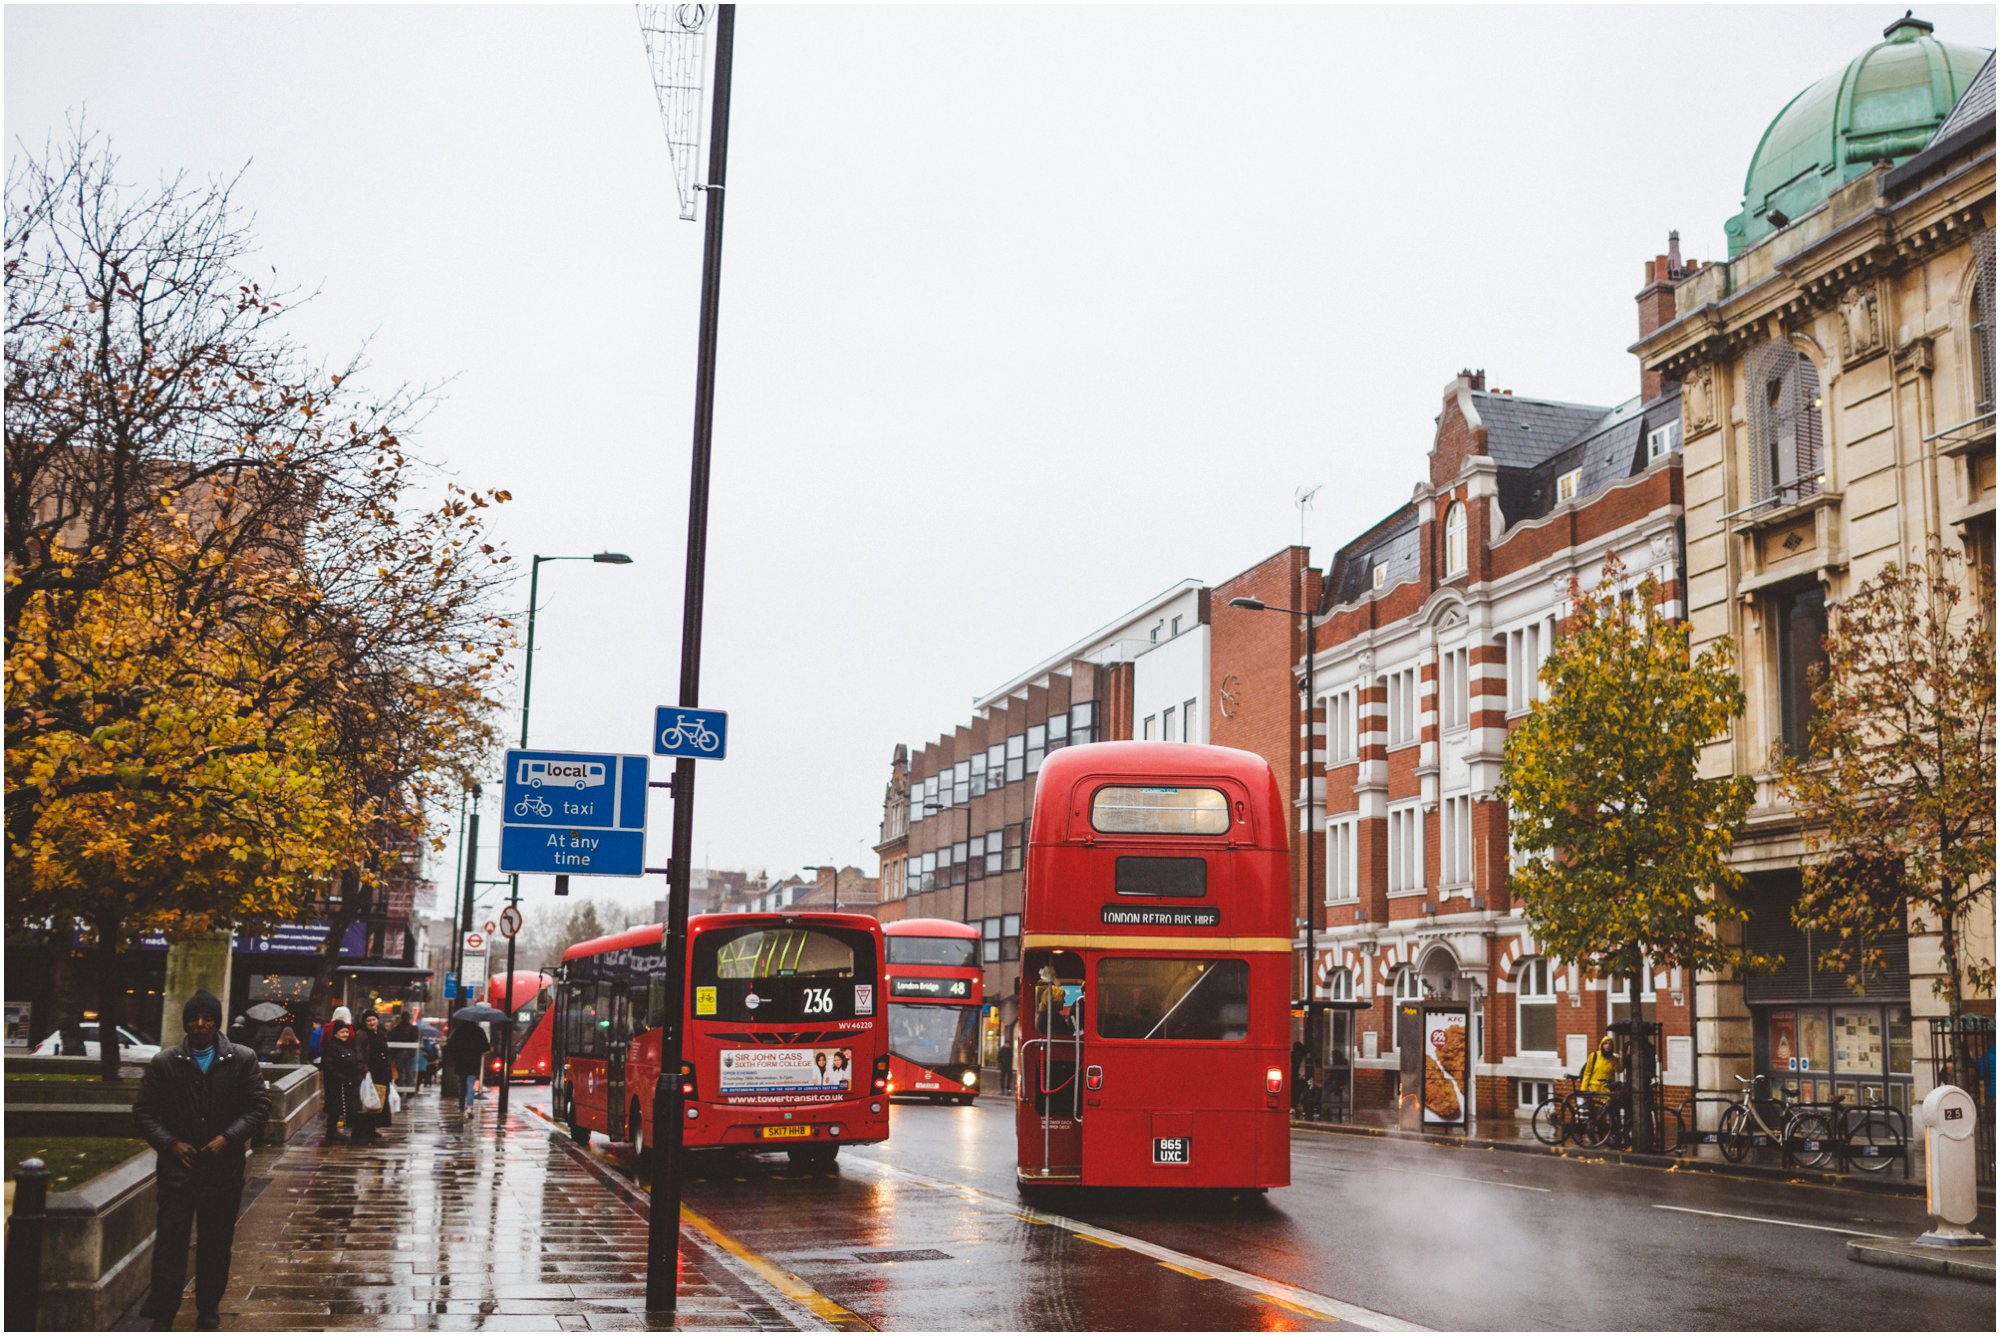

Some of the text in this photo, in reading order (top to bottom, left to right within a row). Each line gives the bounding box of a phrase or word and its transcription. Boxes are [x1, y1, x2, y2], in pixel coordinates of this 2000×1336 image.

[548, 763, 587, 777] local
[563, 801, 594, 815] taxi
[547, 834, 600, 851] At any
[554, 851, 591, 866] time
[1104, 912, 1215, 925] LONDON RETRO BUS HIRE
[897, 982, 939, 992] London Bridge
[950, 982, 965, 994] 48
[803, 988, 833, 1013] 236
[852, 1021, 873, 1029] 46220
[728, 1093, 843, 1103] www.towertransit.co.uk
[768, 1126, 806, 1136] SK17 HHB
[1160, 1139, 1182, 1149] 865
[1160, 1151, 1182, 1161] UXC
